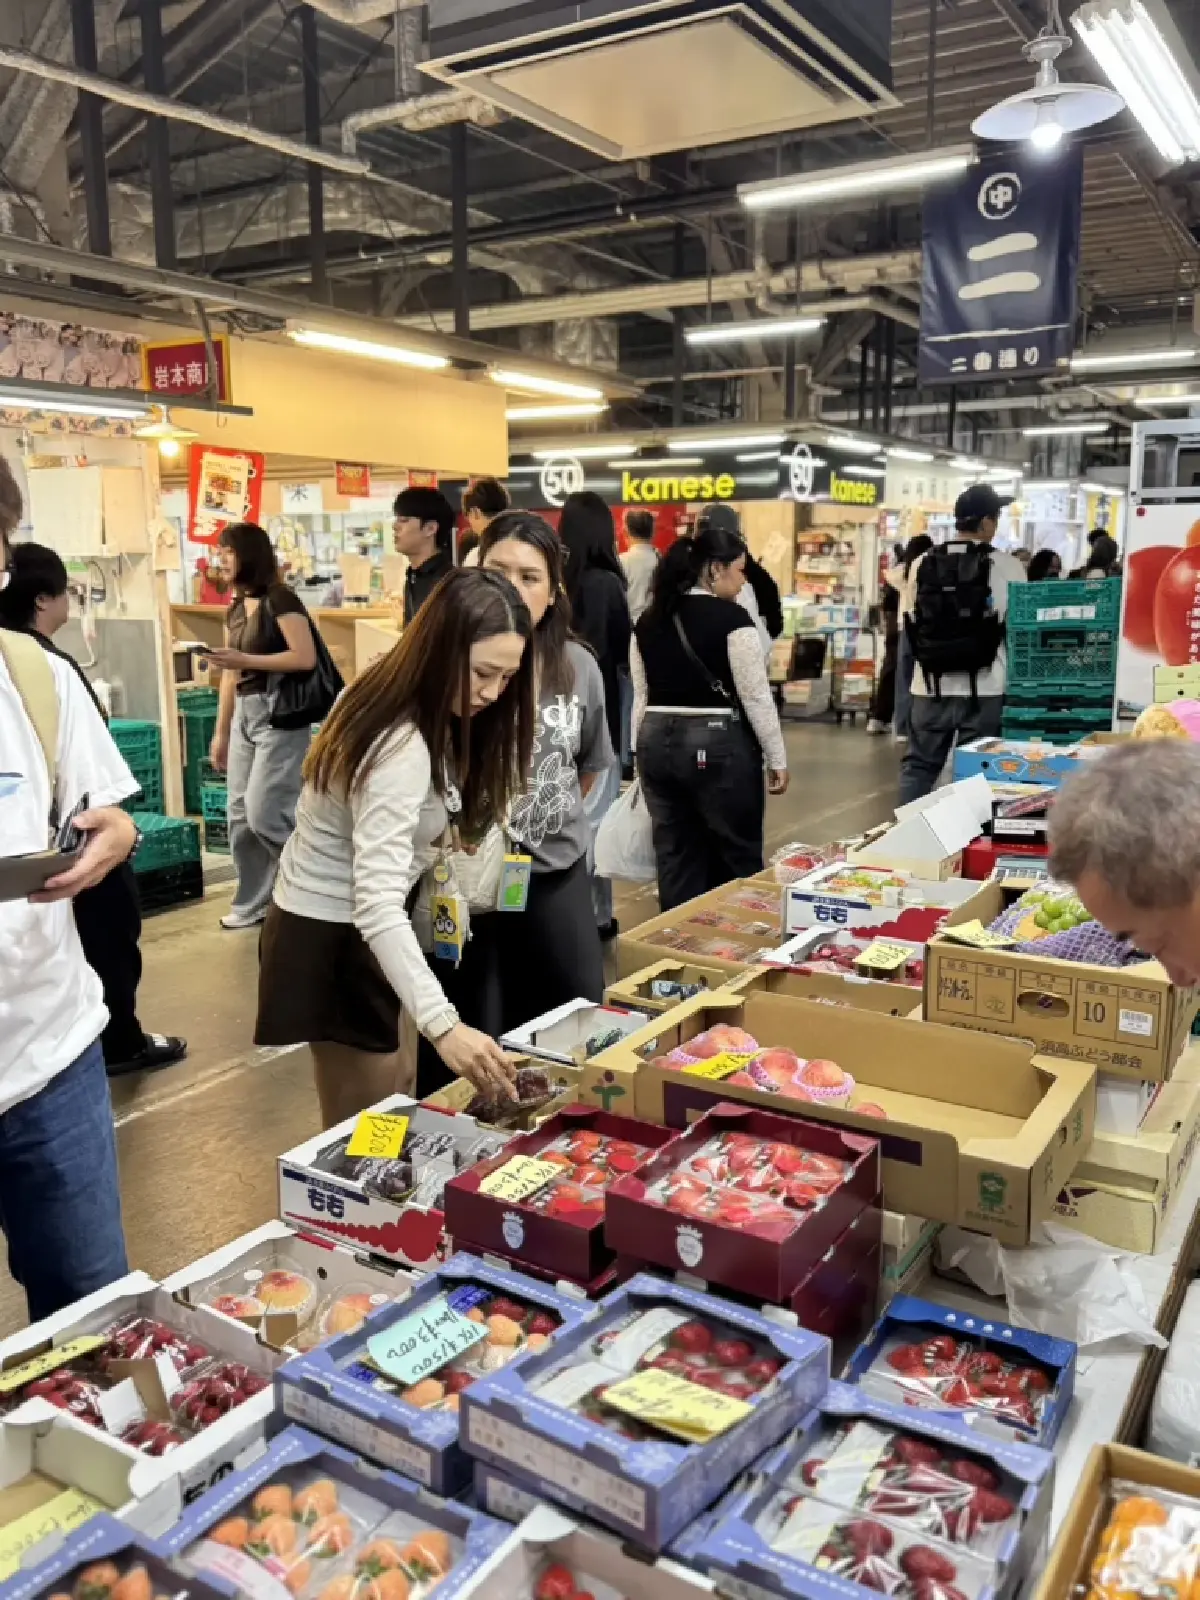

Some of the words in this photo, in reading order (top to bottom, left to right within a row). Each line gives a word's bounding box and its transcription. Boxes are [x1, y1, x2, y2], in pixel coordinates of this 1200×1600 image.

[958, 232, 1041, 299] 二
[622, 471, 735, 502] kanese
[830, 471, 877, 503] kanese
[813, 904, 848, 924] もも
[1082, 1000, 1106, 1023] 10
[308, 1188, 345, 1219] もも
